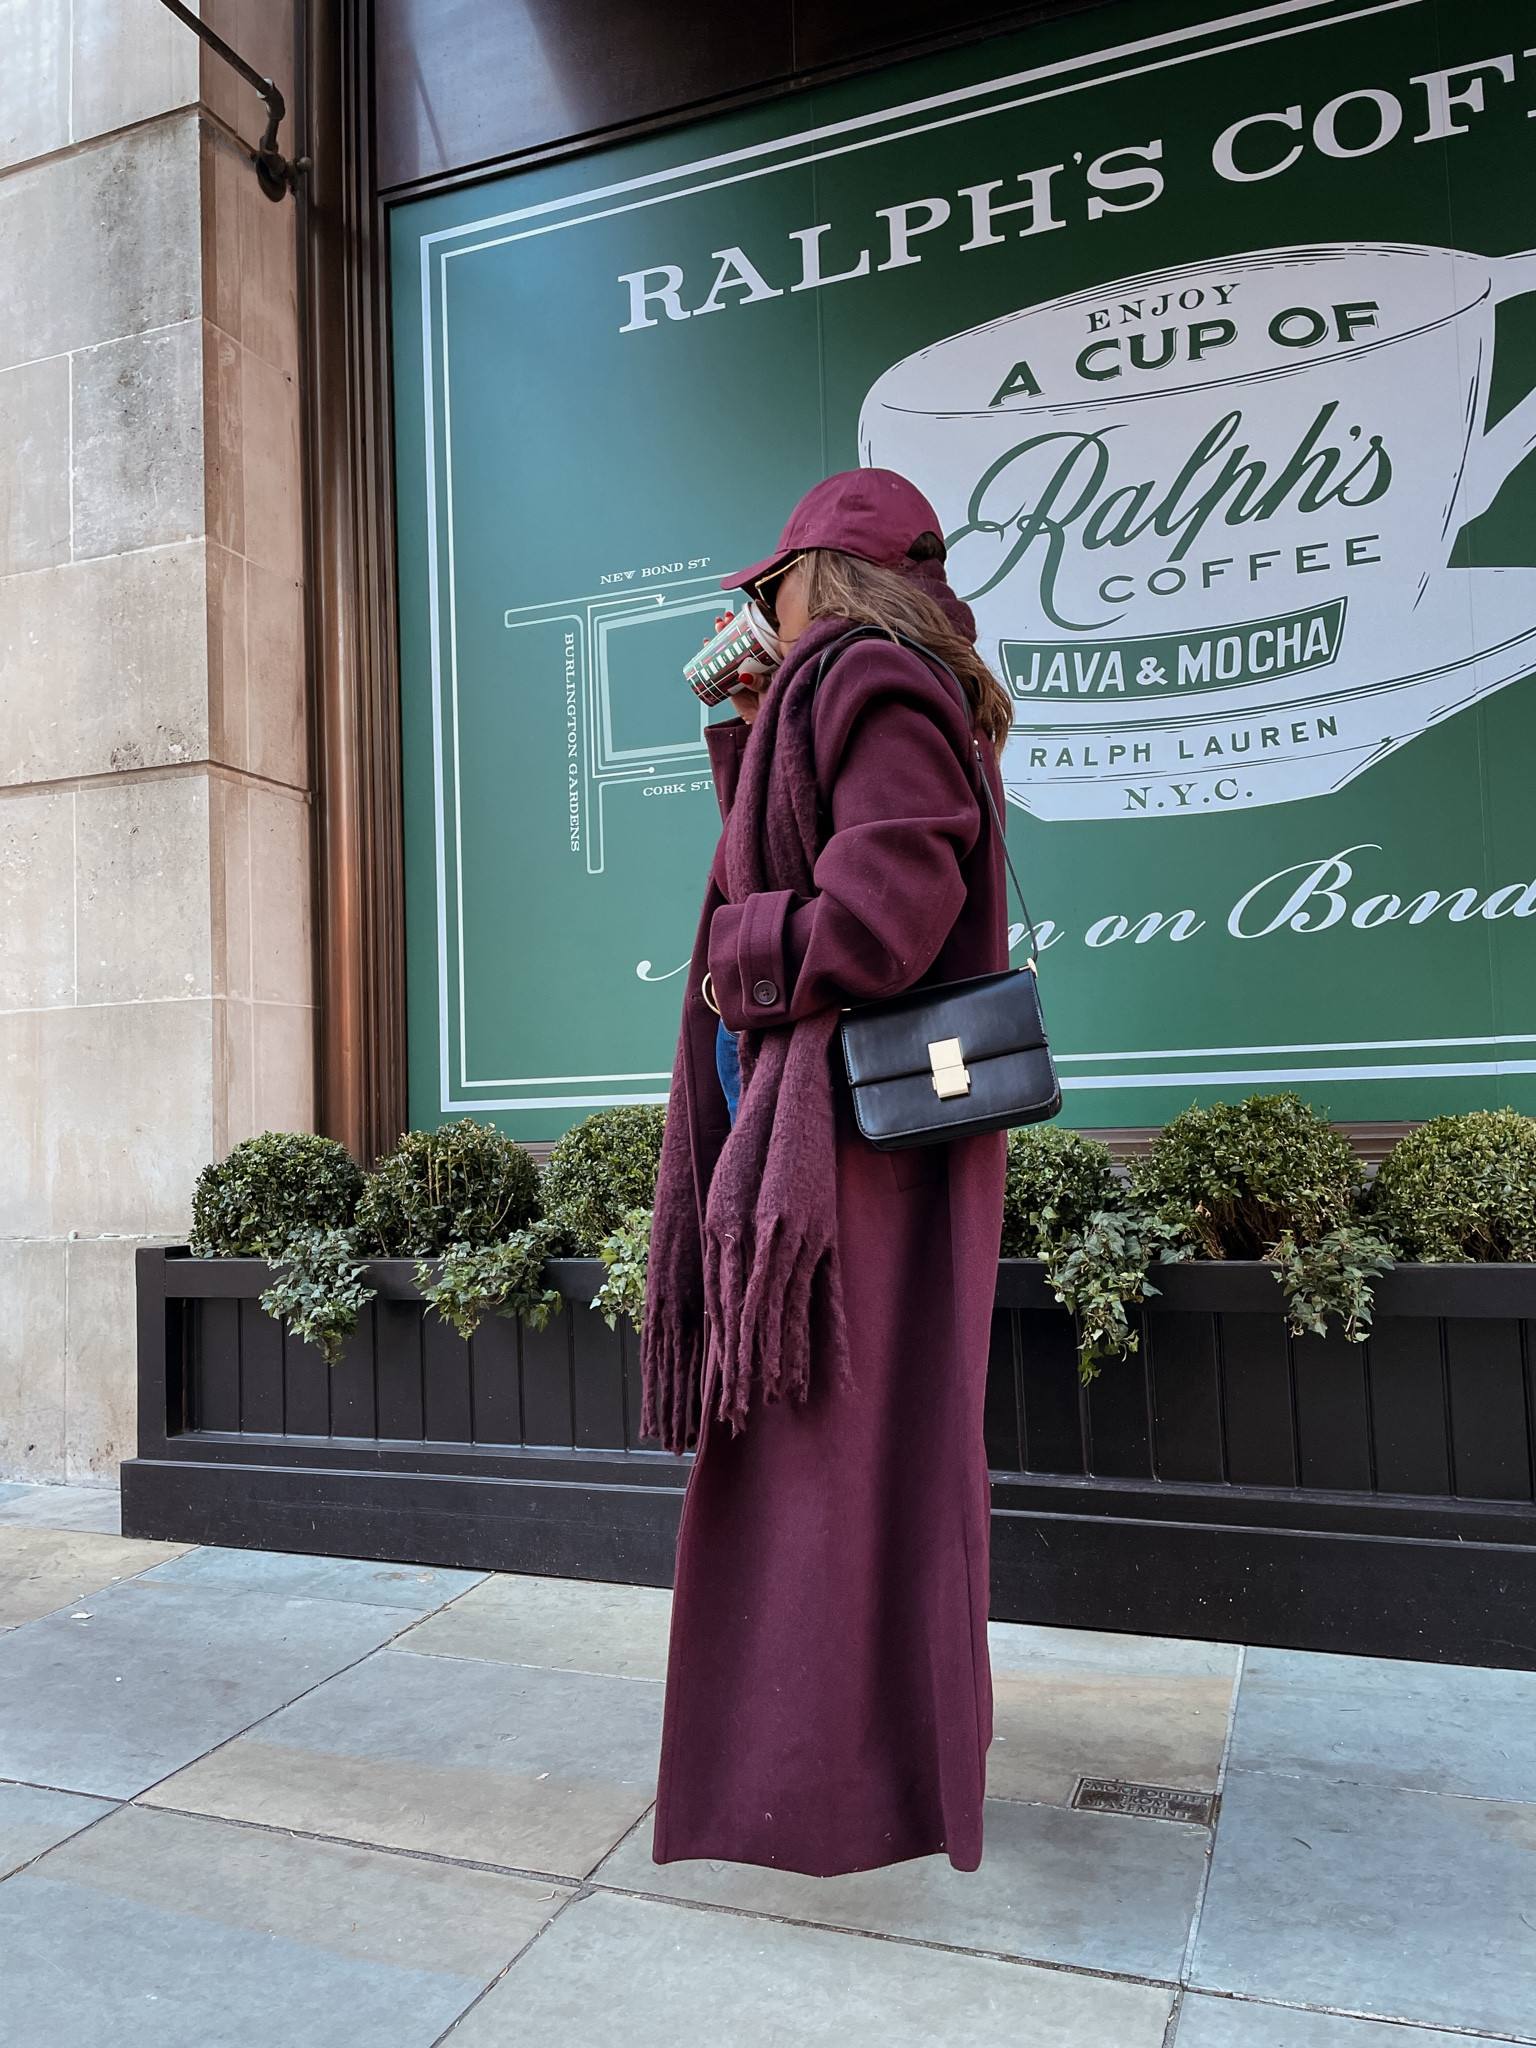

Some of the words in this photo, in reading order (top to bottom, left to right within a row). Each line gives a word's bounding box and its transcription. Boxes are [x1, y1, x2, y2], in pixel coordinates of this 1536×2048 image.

[618, 139, 1164, 333] RALPH'S
[1212, 48, 1536, 183] COF
[1086, 283, 1241, 334] ENJOY
[988, 361, 1045, 408] A
[1075, 319, 1238, 381] CUP
[1268, 301, 1380, 349] OF
[939, 400, 1393, 632] Ralph's
[600, 570, 636, 585] NEW
[641, 562, 684, 578] BOND
[687, 557, 711, 570] ST
[1099, 534, 1382, 604] COFFEE
[1015, 651, 1126, 693] JAVA
[1135, 656, 1168, 686] &
[1177, 616, 1331, 686] MOCHA
[564, 632, 577, 759] BURLINGTON
[1029, 742, 1152, 768] RALPH
[1178, 715, 1338, 760] LAUREN
[568, 763, 580, 852] GARDENS
[643, 783, 686, 797] CORK
[690, 780, 713, 792] ST
[1122, 778, 1254, 811] N.Y.C.
[1084, 910, 1206, 951] on
[1227, 843, 1536, 939] Bond
[1083, 1781, 1139, 1795] SMOKE
[1093, 1801, 1191, 1819] BASEMENT
[1122, 1795, 1169, 1809] FROM
